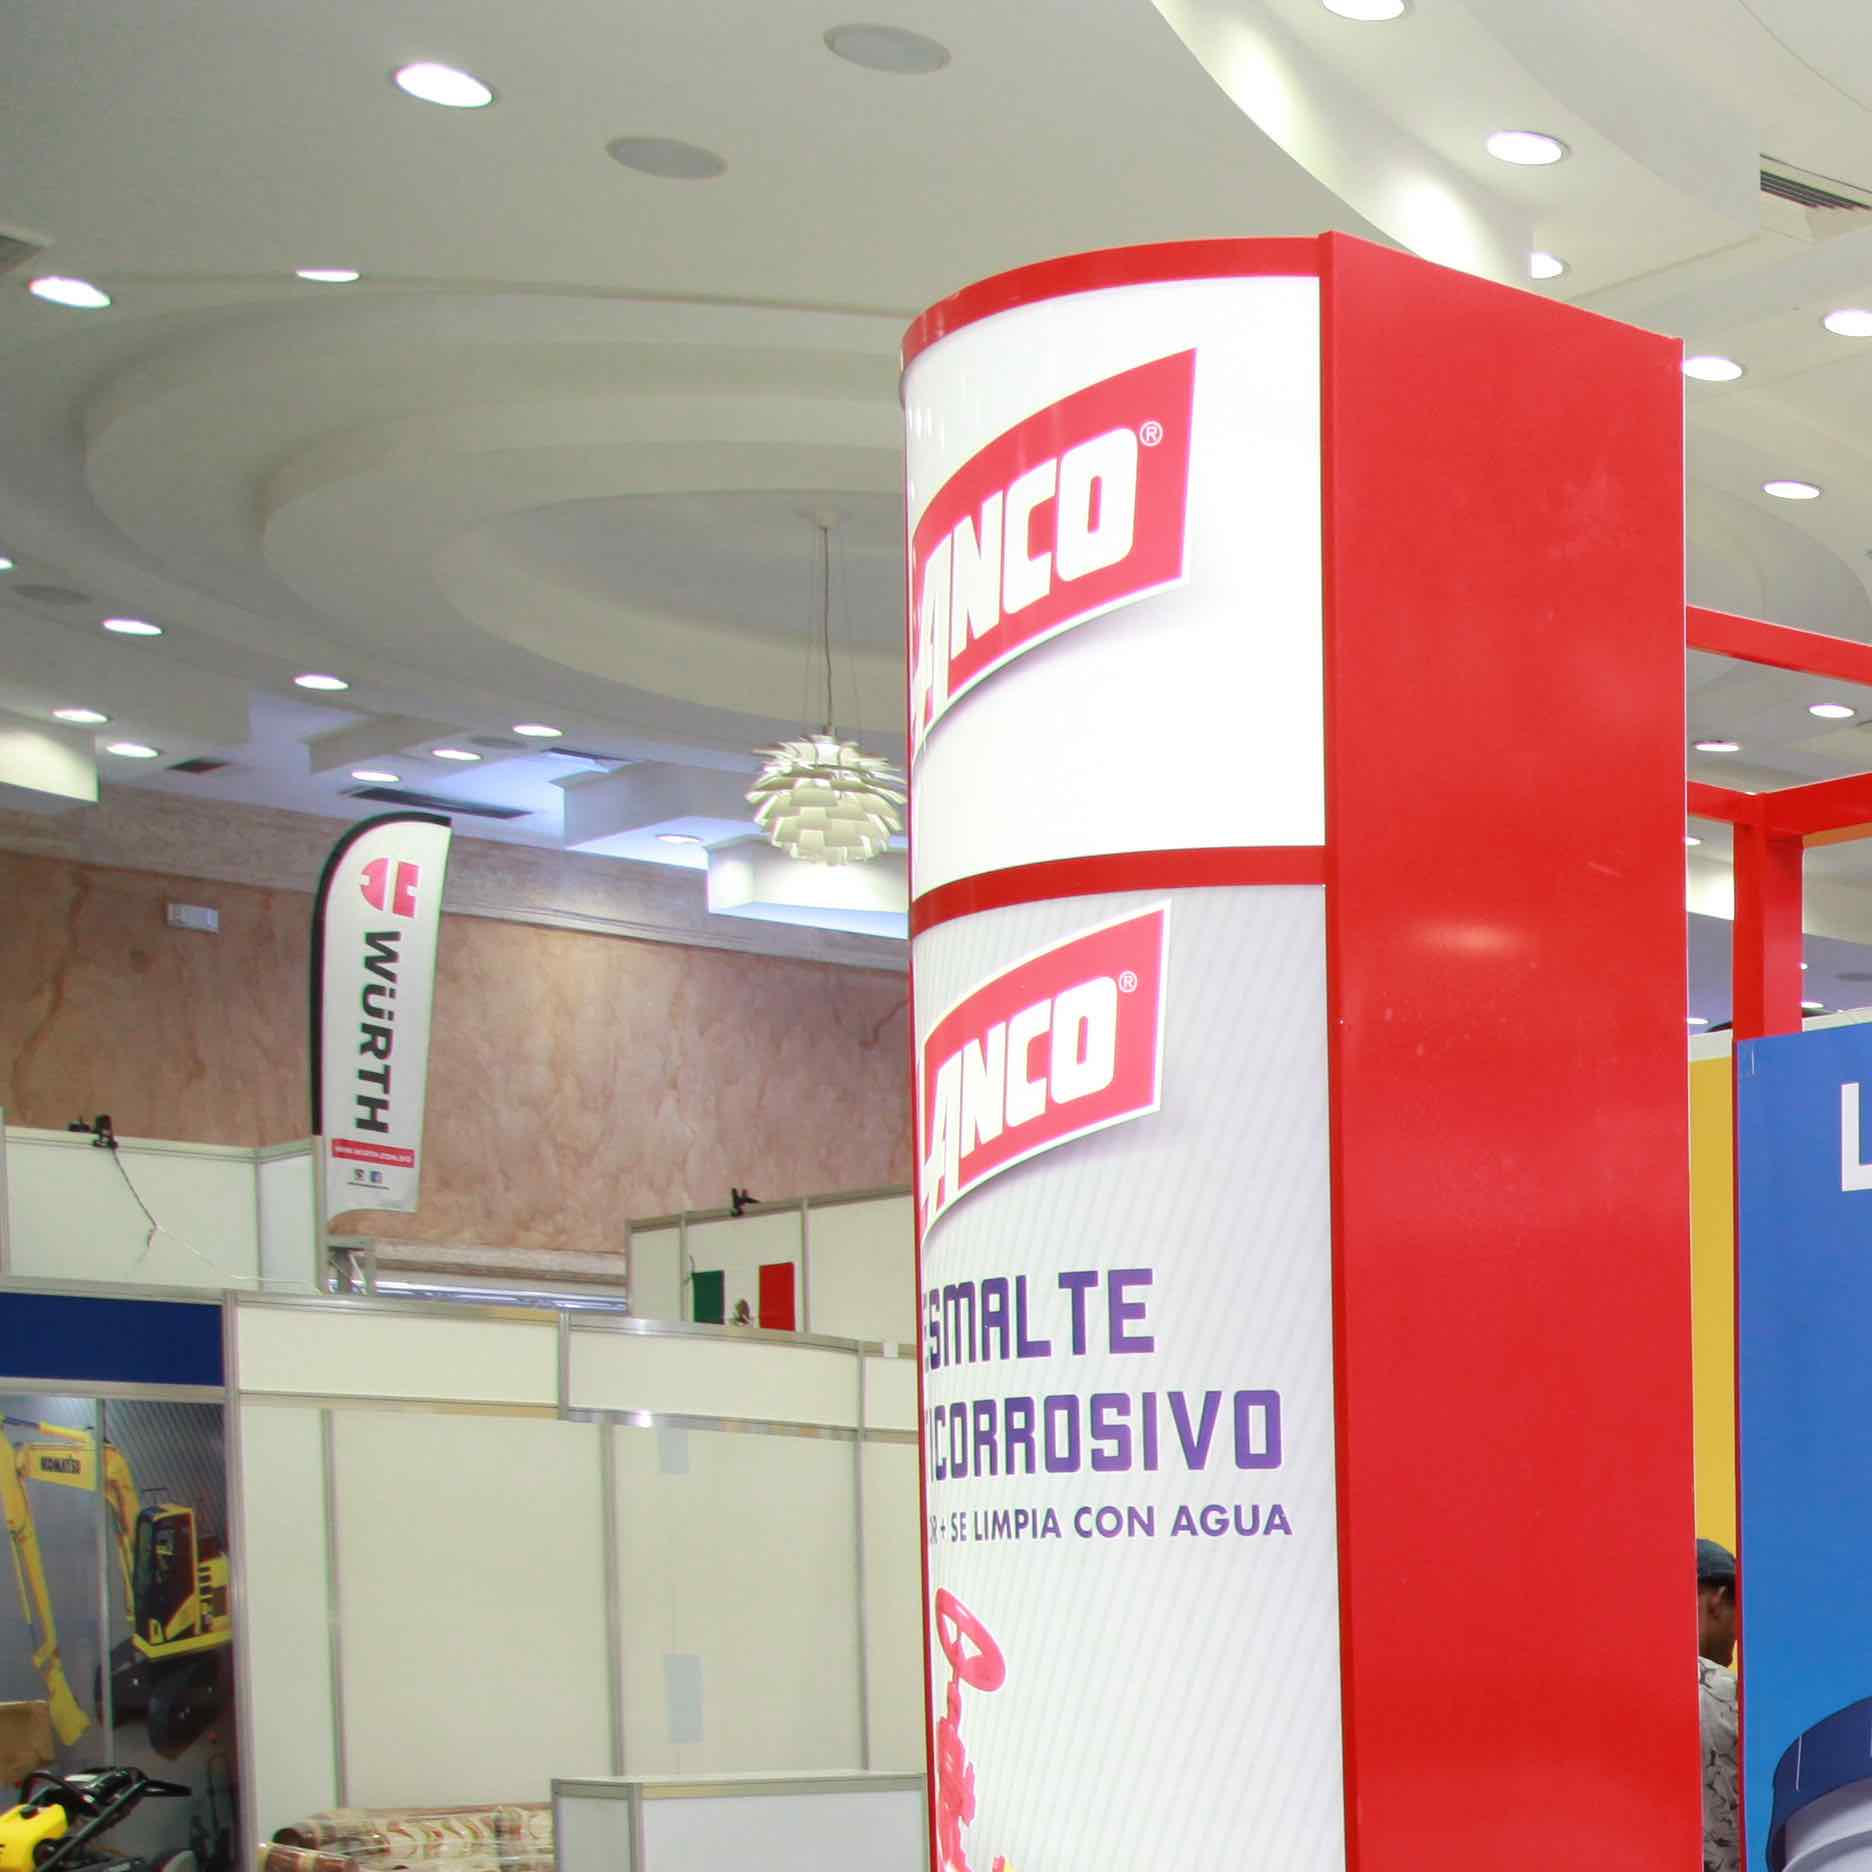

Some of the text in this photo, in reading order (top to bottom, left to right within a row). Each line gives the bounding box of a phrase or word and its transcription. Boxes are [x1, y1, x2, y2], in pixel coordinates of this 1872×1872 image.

[912, 426, 1139, 732] ANCO
[355, 930, 402, 1134] WÜRTH
[924, 1268, 1155, 1373] SMALTE
[951, 1512, 967, 1543] SE
[974, 1508, 1062, 1541] LIMPIA
[1074, 1506, 1155, 1538] CON
[1171, 1504, 1293, 1536] AGUA
